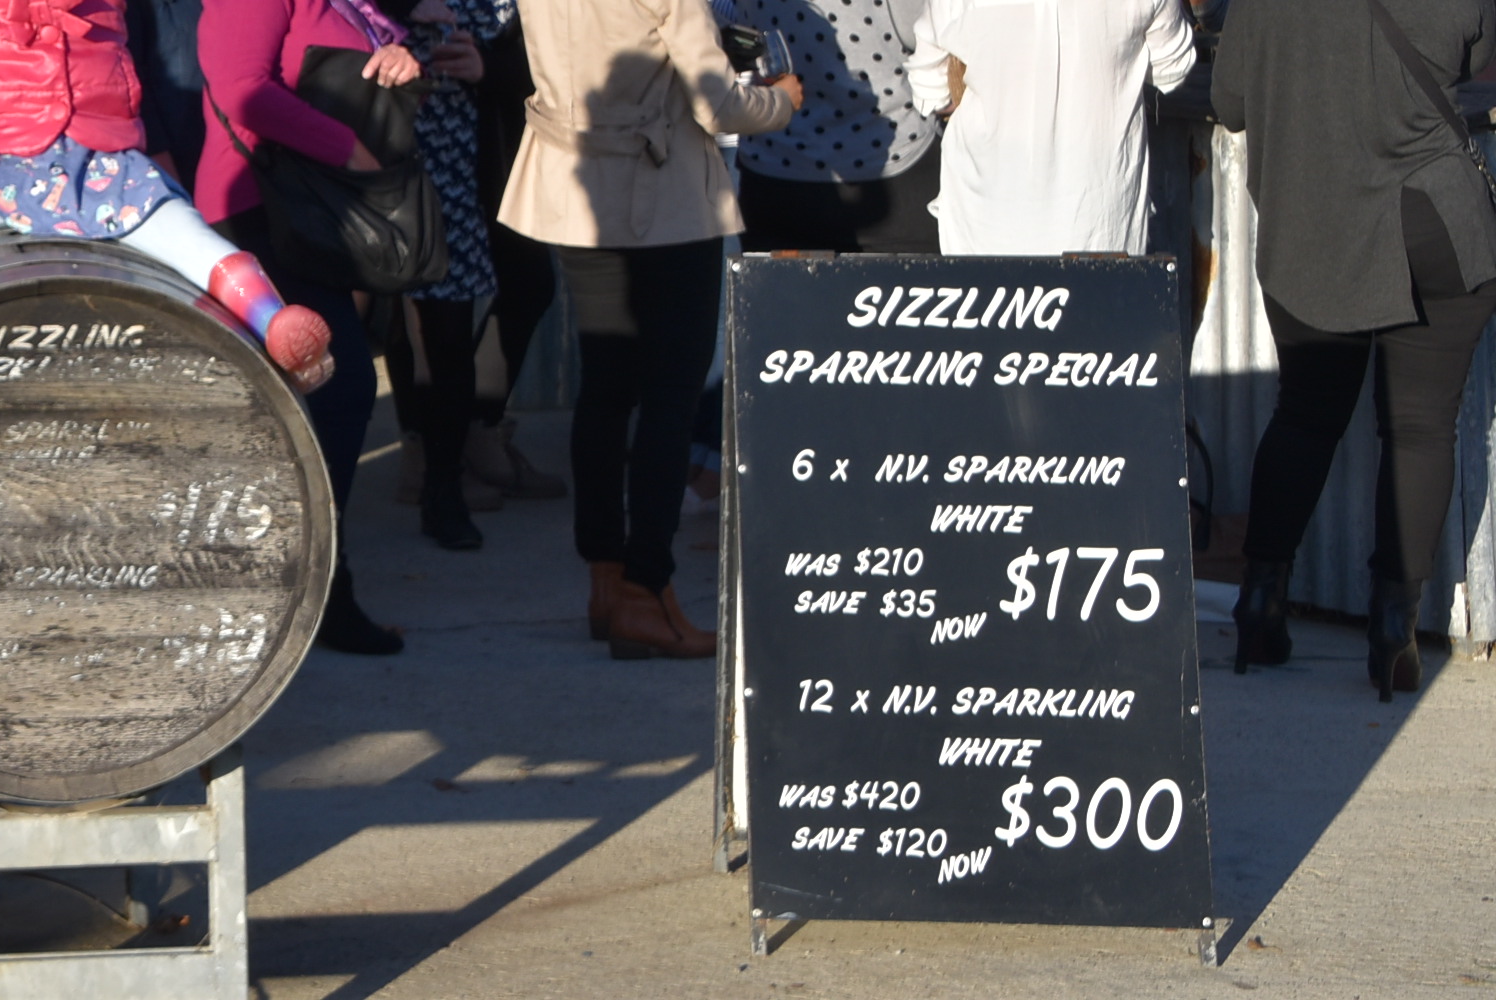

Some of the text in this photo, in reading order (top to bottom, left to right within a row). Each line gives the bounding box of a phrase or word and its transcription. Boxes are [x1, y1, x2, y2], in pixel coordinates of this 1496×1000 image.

[847, 286, 1070, 332] SIZZLING
[760, 350, 1158, 388] SPARKLING SPECIAL
[791, 448, 816, 482] 6
[875, 454, 930, 484] N.V.
[944, 455, 1126, 487] SPARKLING
[930, 505, 1034, 534] WHITE
[784, 547, 924, 577] WAS $210
[999, 546, 1165, 623] $175
[794, 589, 937, 619] SAVE $35
[930, 613, 988, 645] NOW
[799, 679, 834, 714] 12
[882, 685, 938, 716] N.V.
[952, 687, 1136, 721] SPARKLING
[938, 737, 1043, 768] WHITE
[779, 780, 921, 811] WAS $420
[995, 775, 1184, 852] $300
[791, 827, 948, 857] SAVE $120
[938, 848, 993, 885] NOW
